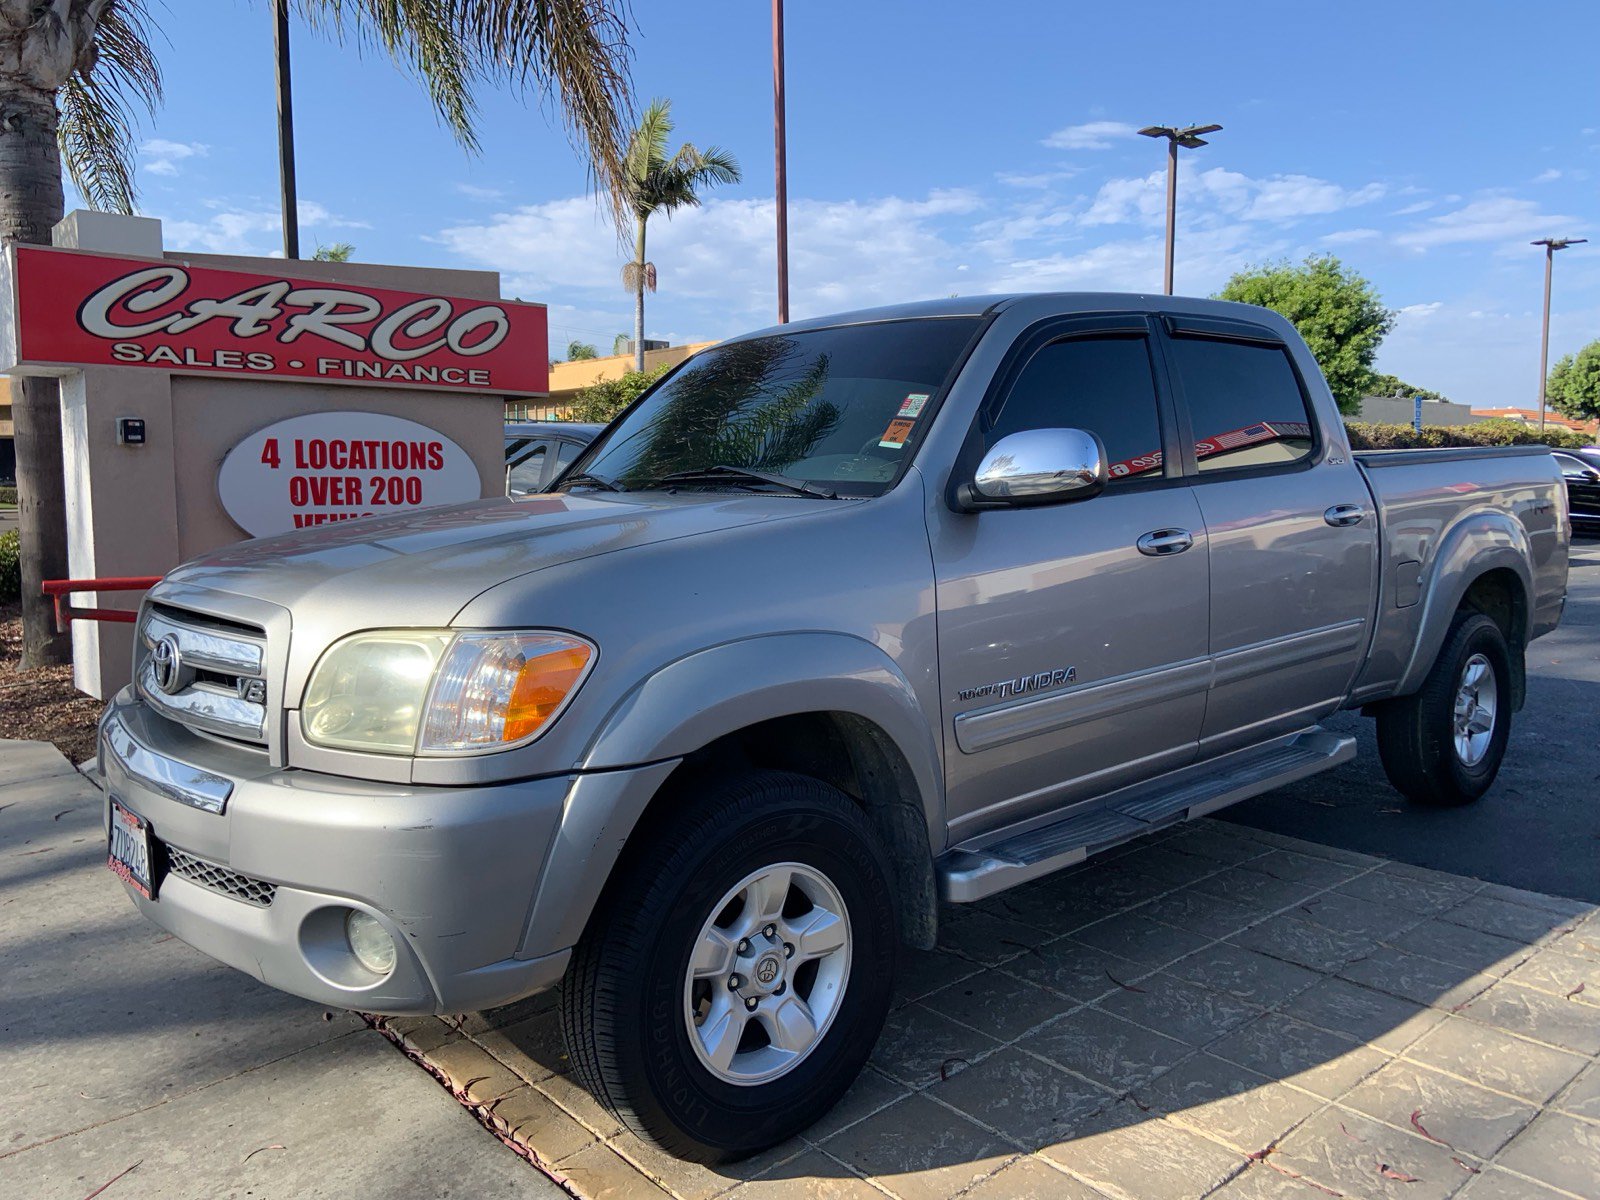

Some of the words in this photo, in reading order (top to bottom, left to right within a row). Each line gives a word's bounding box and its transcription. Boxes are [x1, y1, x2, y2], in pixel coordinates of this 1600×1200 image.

[77, 266, 510, 361] CARCO
[111, 343, 275, 370] SALES
[317, 357, 491, 386] FINANCE
[261, 438, 281, 469] 4
[294, 438, 444, 471] LOCATIONS
[289, 475, 363, 507] OVER
[369, 475, 423, 505] 200
[999, 665, 1077, 698] TUNDRA
